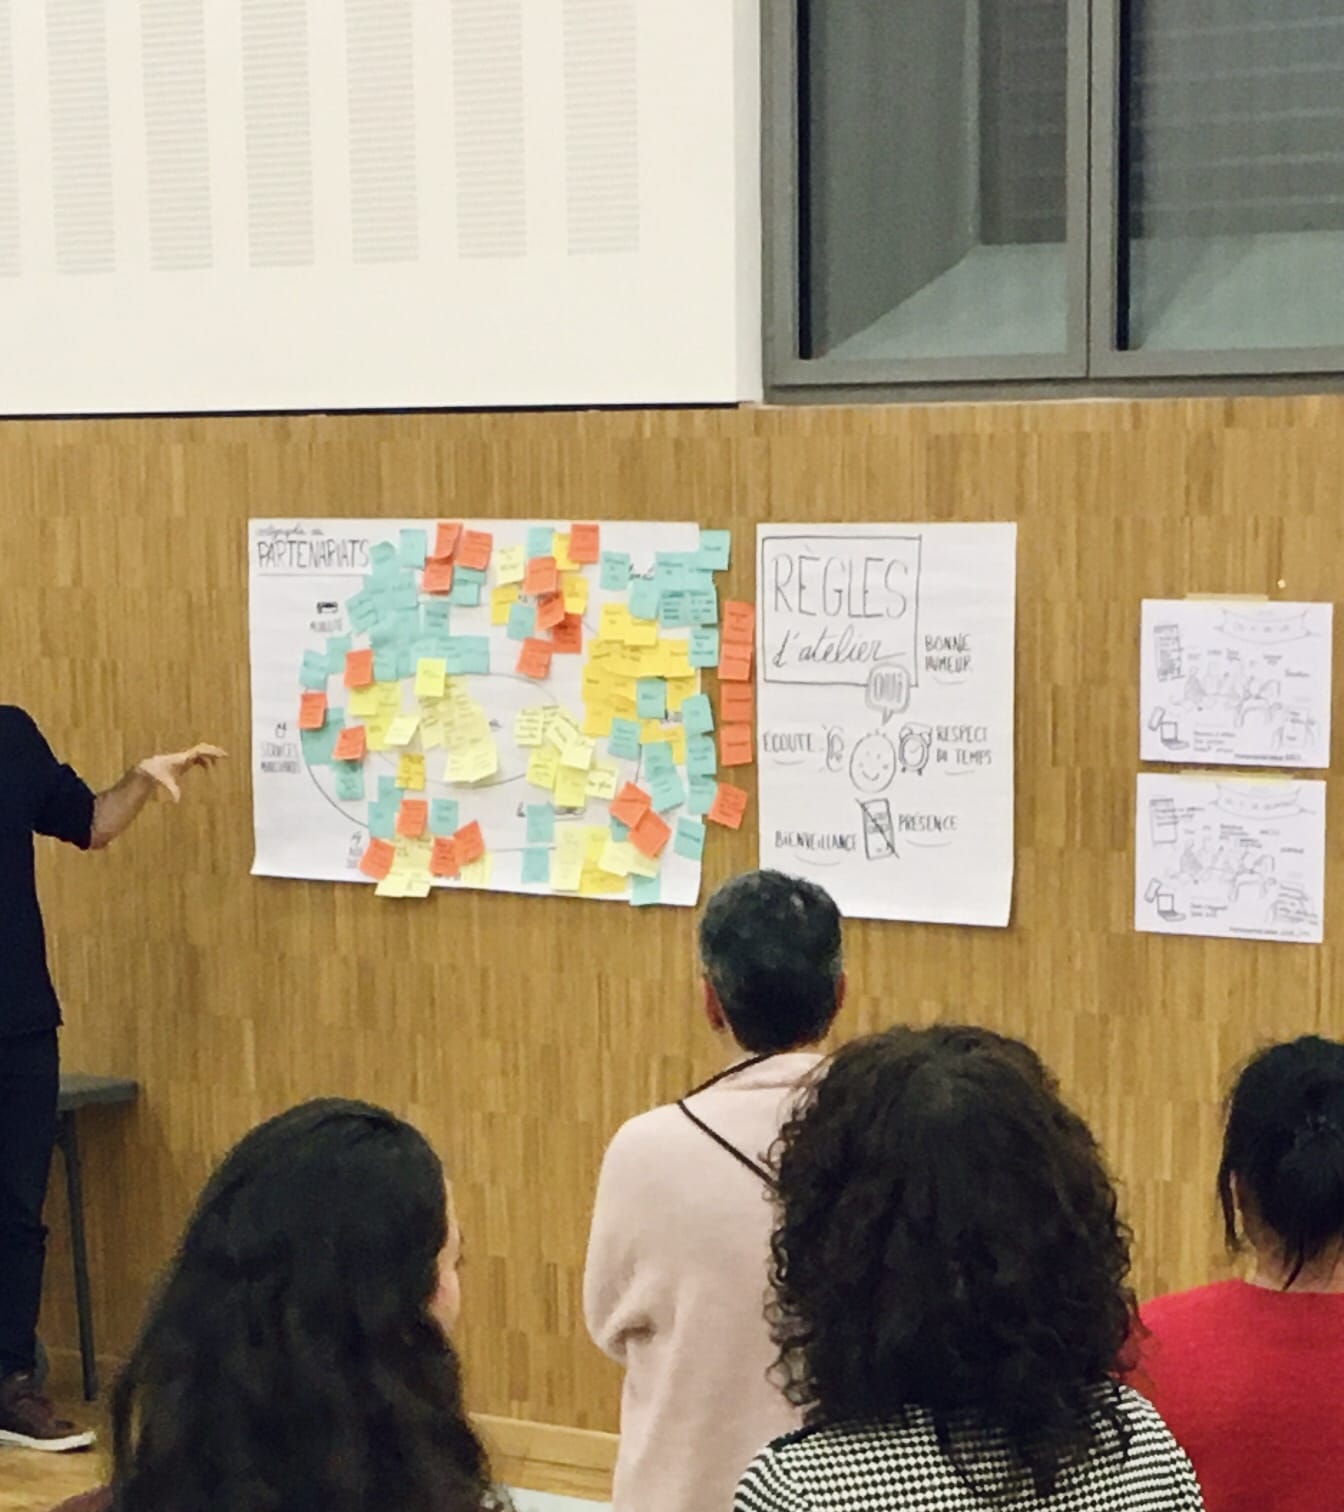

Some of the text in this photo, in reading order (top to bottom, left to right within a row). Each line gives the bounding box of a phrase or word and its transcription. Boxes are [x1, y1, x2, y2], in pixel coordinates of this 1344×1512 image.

[257, 539, 369, 569] PARTENARIATS
[773, 544, 908, 618] RÈGLES
[925, 633, 972, 653] BONNE
[925, 655, 972, 674] HUMEUR
[936, 725, 988, 743] RESPECT
[956, 748, 992, 766] TEMPS
